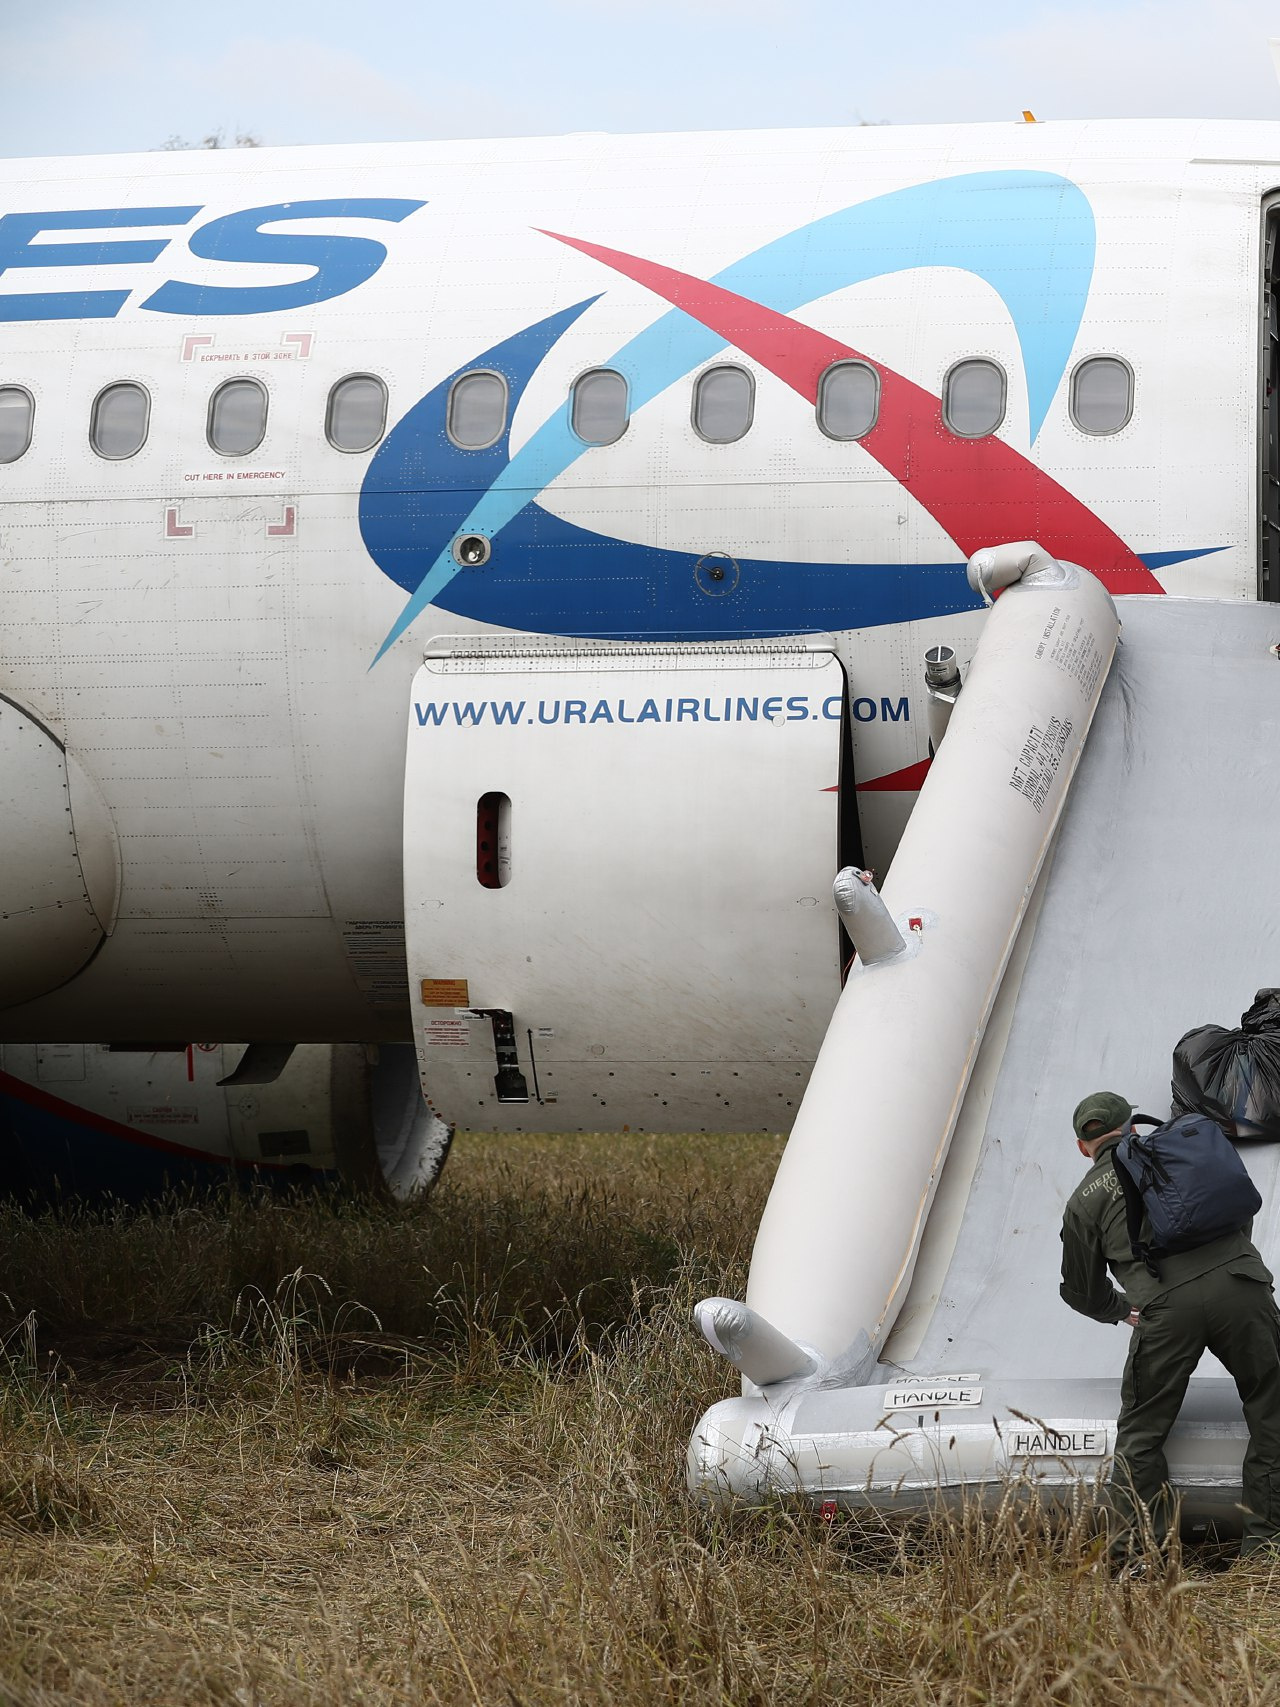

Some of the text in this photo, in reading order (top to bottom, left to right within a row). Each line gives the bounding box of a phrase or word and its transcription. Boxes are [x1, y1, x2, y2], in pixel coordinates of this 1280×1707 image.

[184, 471, 286, 482] CUT HERE IN EMERGENCY
[414, 695, 910, 727] WWW.URALAIRLINES.COM
[1008, 724, 1044, 792] RAFT CAPACITY
[894, 1390, 971, 1405] HANDLE
[1016, 1434, 1096, 1450] HANDLE
